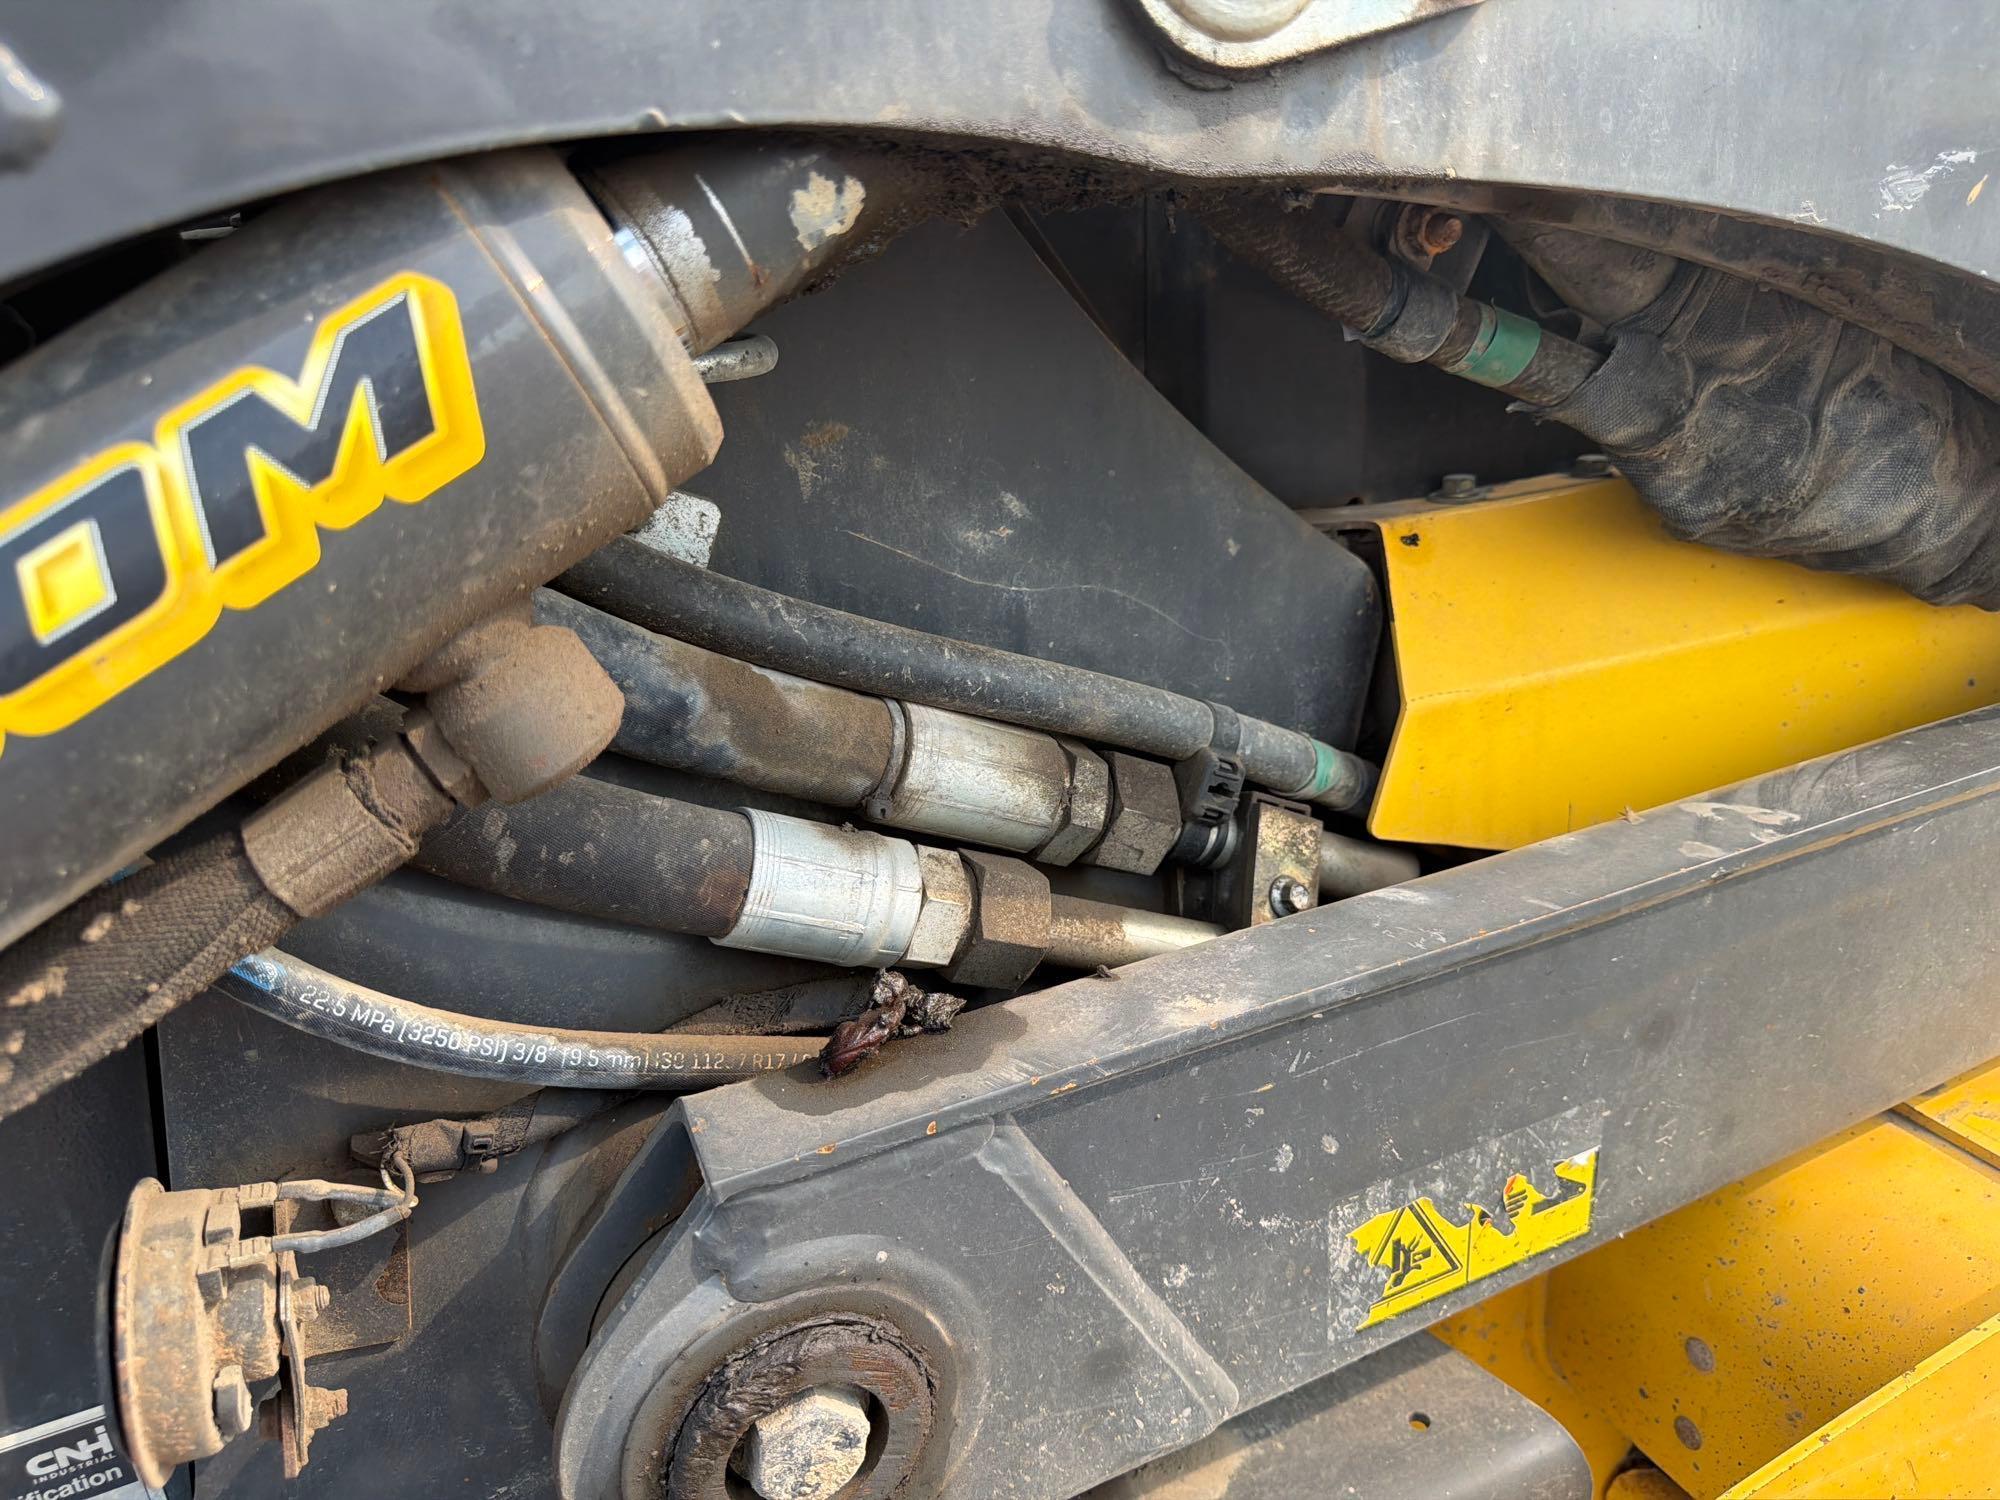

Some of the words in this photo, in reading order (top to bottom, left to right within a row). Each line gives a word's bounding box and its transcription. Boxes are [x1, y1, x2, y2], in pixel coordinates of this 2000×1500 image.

[299, 984, 347, 1018] 22.5
[350, 1003, 395, 1036] MPa
[692, 1052, 746, 1070] 1127
[752, 1052, 785, 1070] R17
[32, 1452, 118, 1486] INDUSTRIAL
